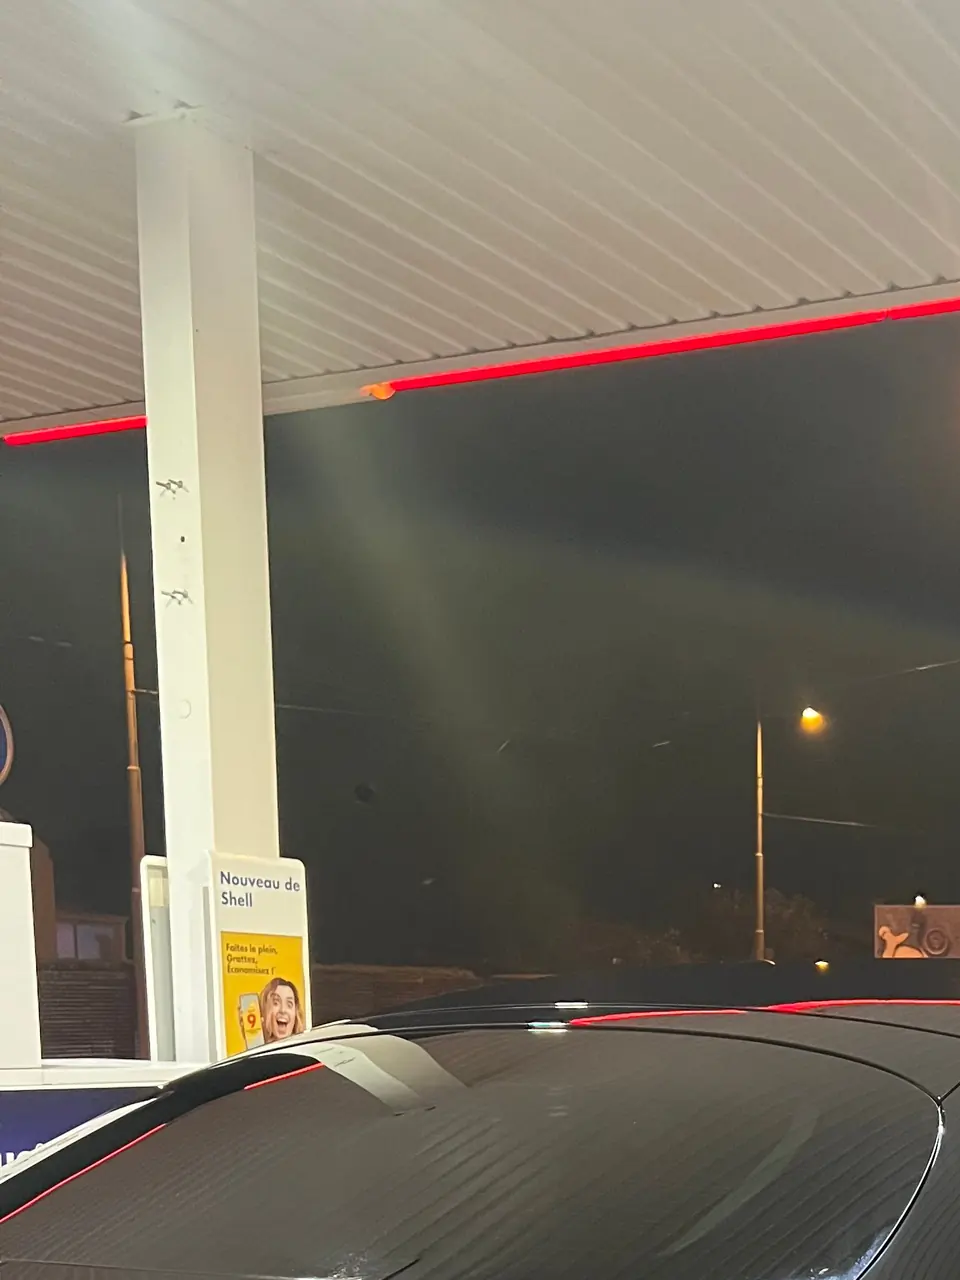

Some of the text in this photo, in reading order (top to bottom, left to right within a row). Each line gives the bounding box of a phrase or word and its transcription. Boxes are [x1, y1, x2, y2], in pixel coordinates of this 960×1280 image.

[220, 870, 301, 891] Nouveau de
[221, 891, 253, 908] Shell
[226, 943, 248, 953] Faites
[250, 944, 256, 953] le
[247, 1013, 256, 1028] 9
